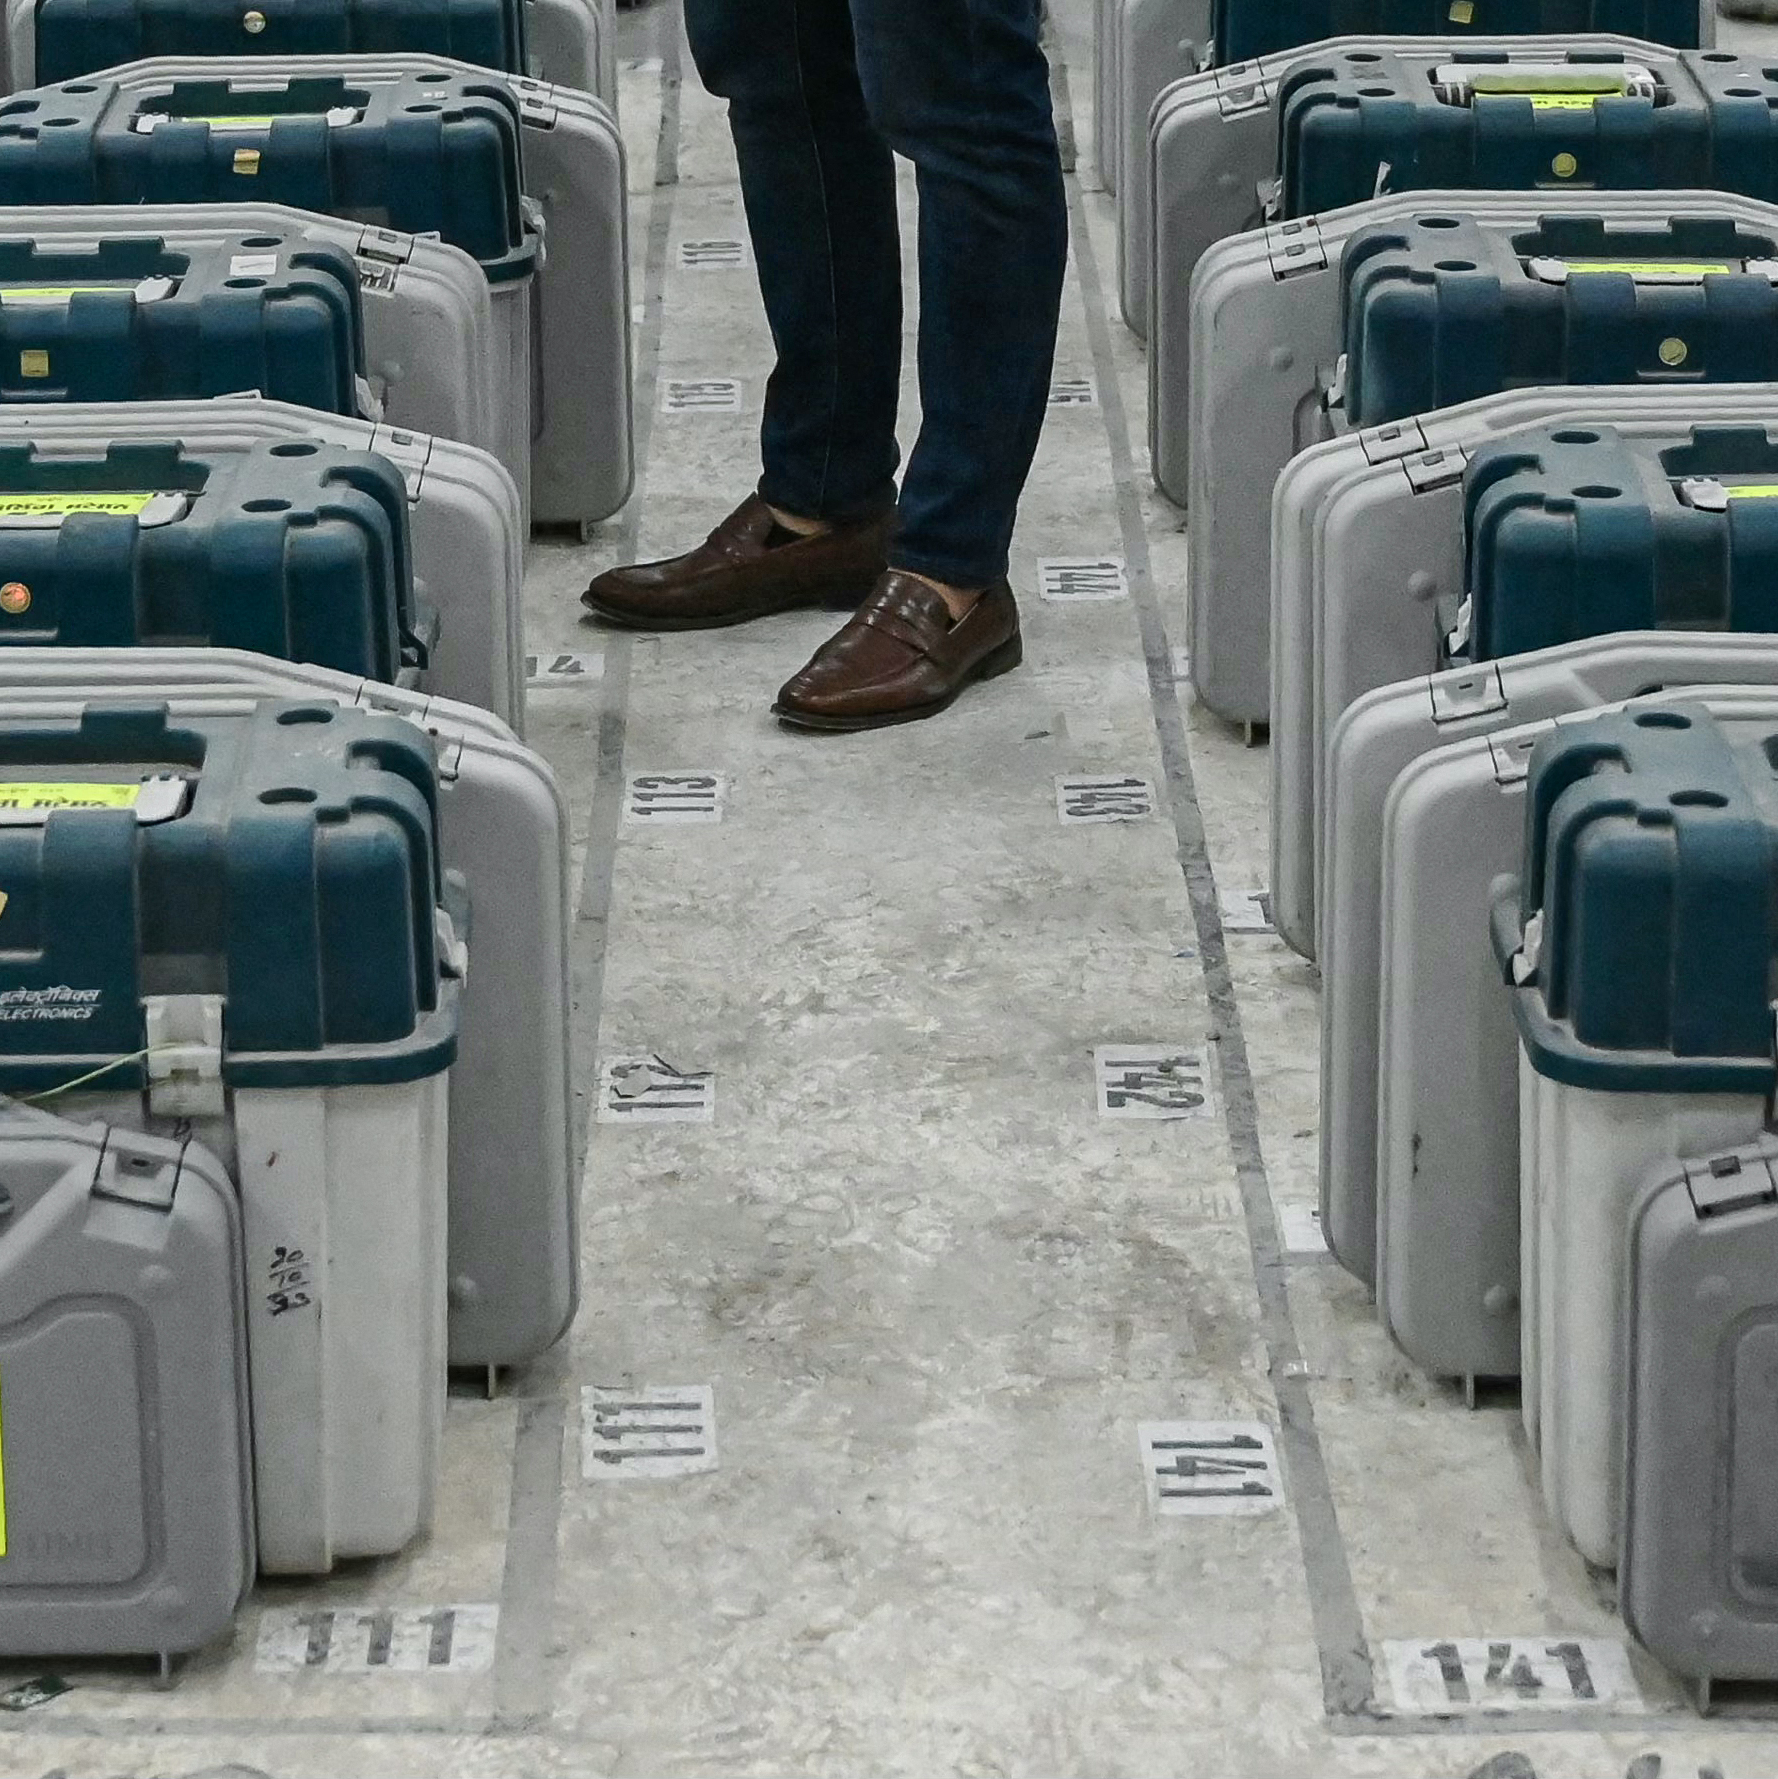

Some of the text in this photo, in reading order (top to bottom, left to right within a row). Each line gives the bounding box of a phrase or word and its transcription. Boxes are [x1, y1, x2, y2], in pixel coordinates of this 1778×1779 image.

[1044, 562, 1120, 594] 144
[631, 776, 717, 816] 113
[1063, 779, 1151, 816] 143
[1104, 1059, 1204, 1108] 142
[592, 1400, 704, 1464] 111
[1151, 1435, 1273, 1497] 141
[295, 1610, 456, 1665] 111
[1421, 1642, 1596, 1703] 141
